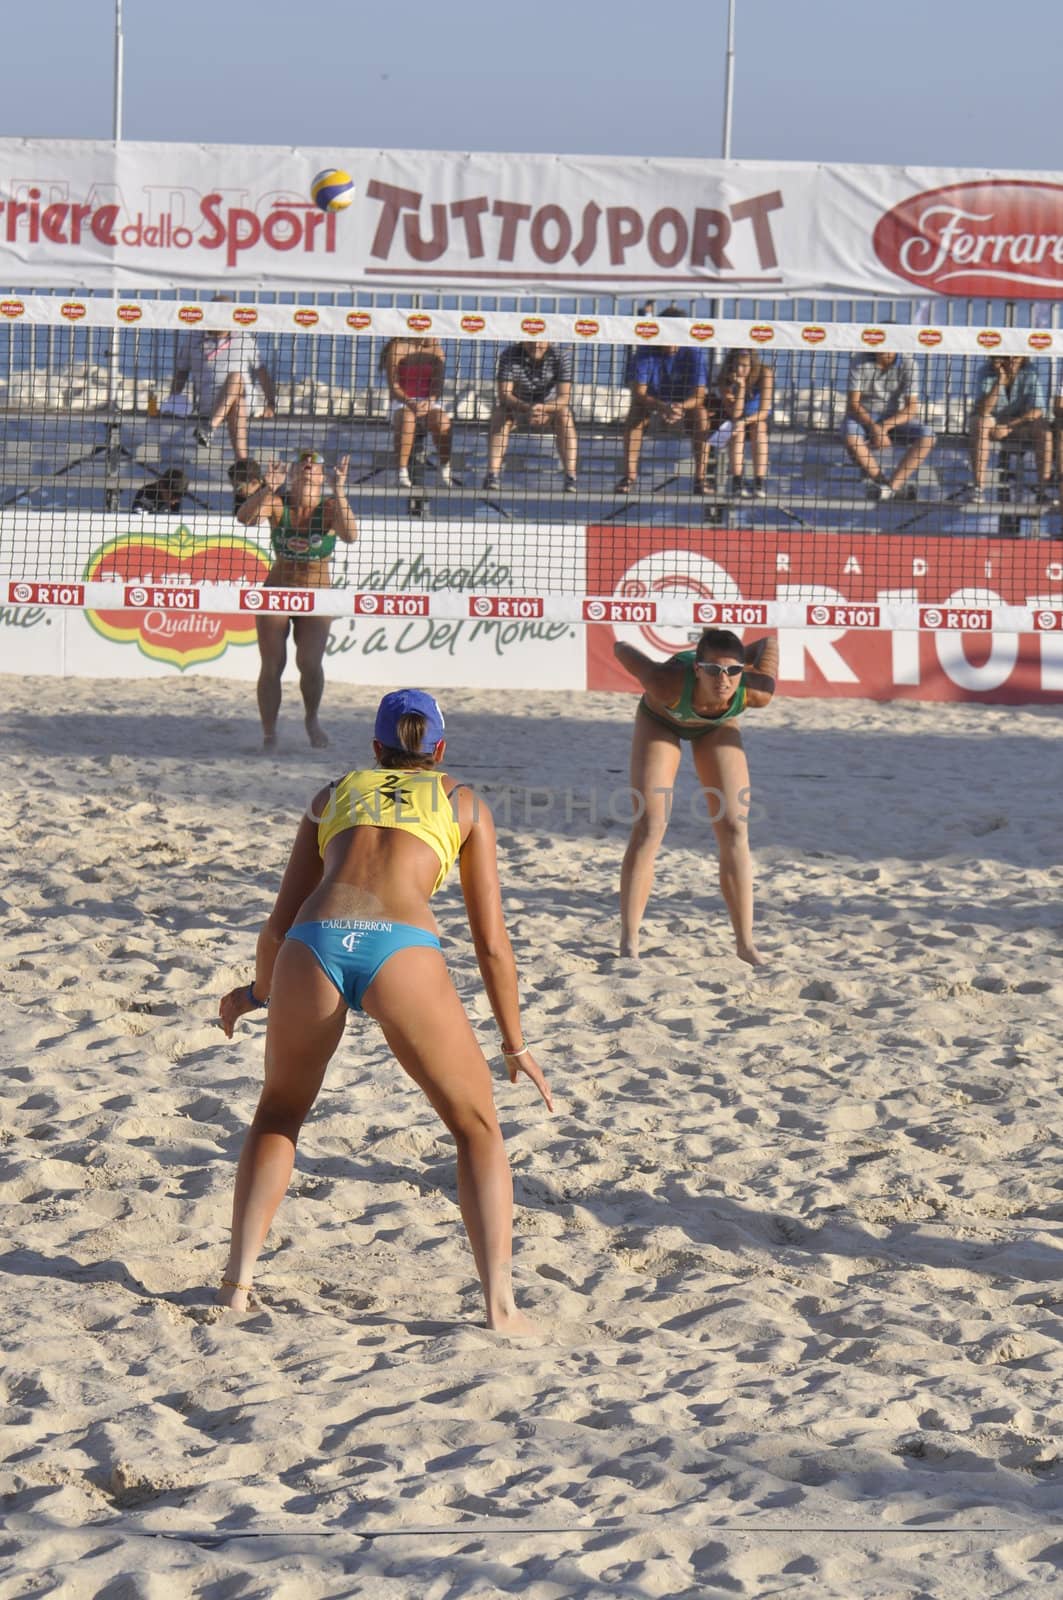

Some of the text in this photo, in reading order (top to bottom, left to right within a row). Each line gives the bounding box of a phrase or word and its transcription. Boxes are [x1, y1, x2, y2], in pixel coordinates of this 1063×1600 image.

[0, 188, 121, 246] riere
[121, 212, 193, 248] dello
[366, 178, 784, 271] TUTTOSPORT
[143, 610, 221, 638] Quality
[381, 775, 399, 789] 2
[321, 919, 393, 933] CARLA FERRONI
